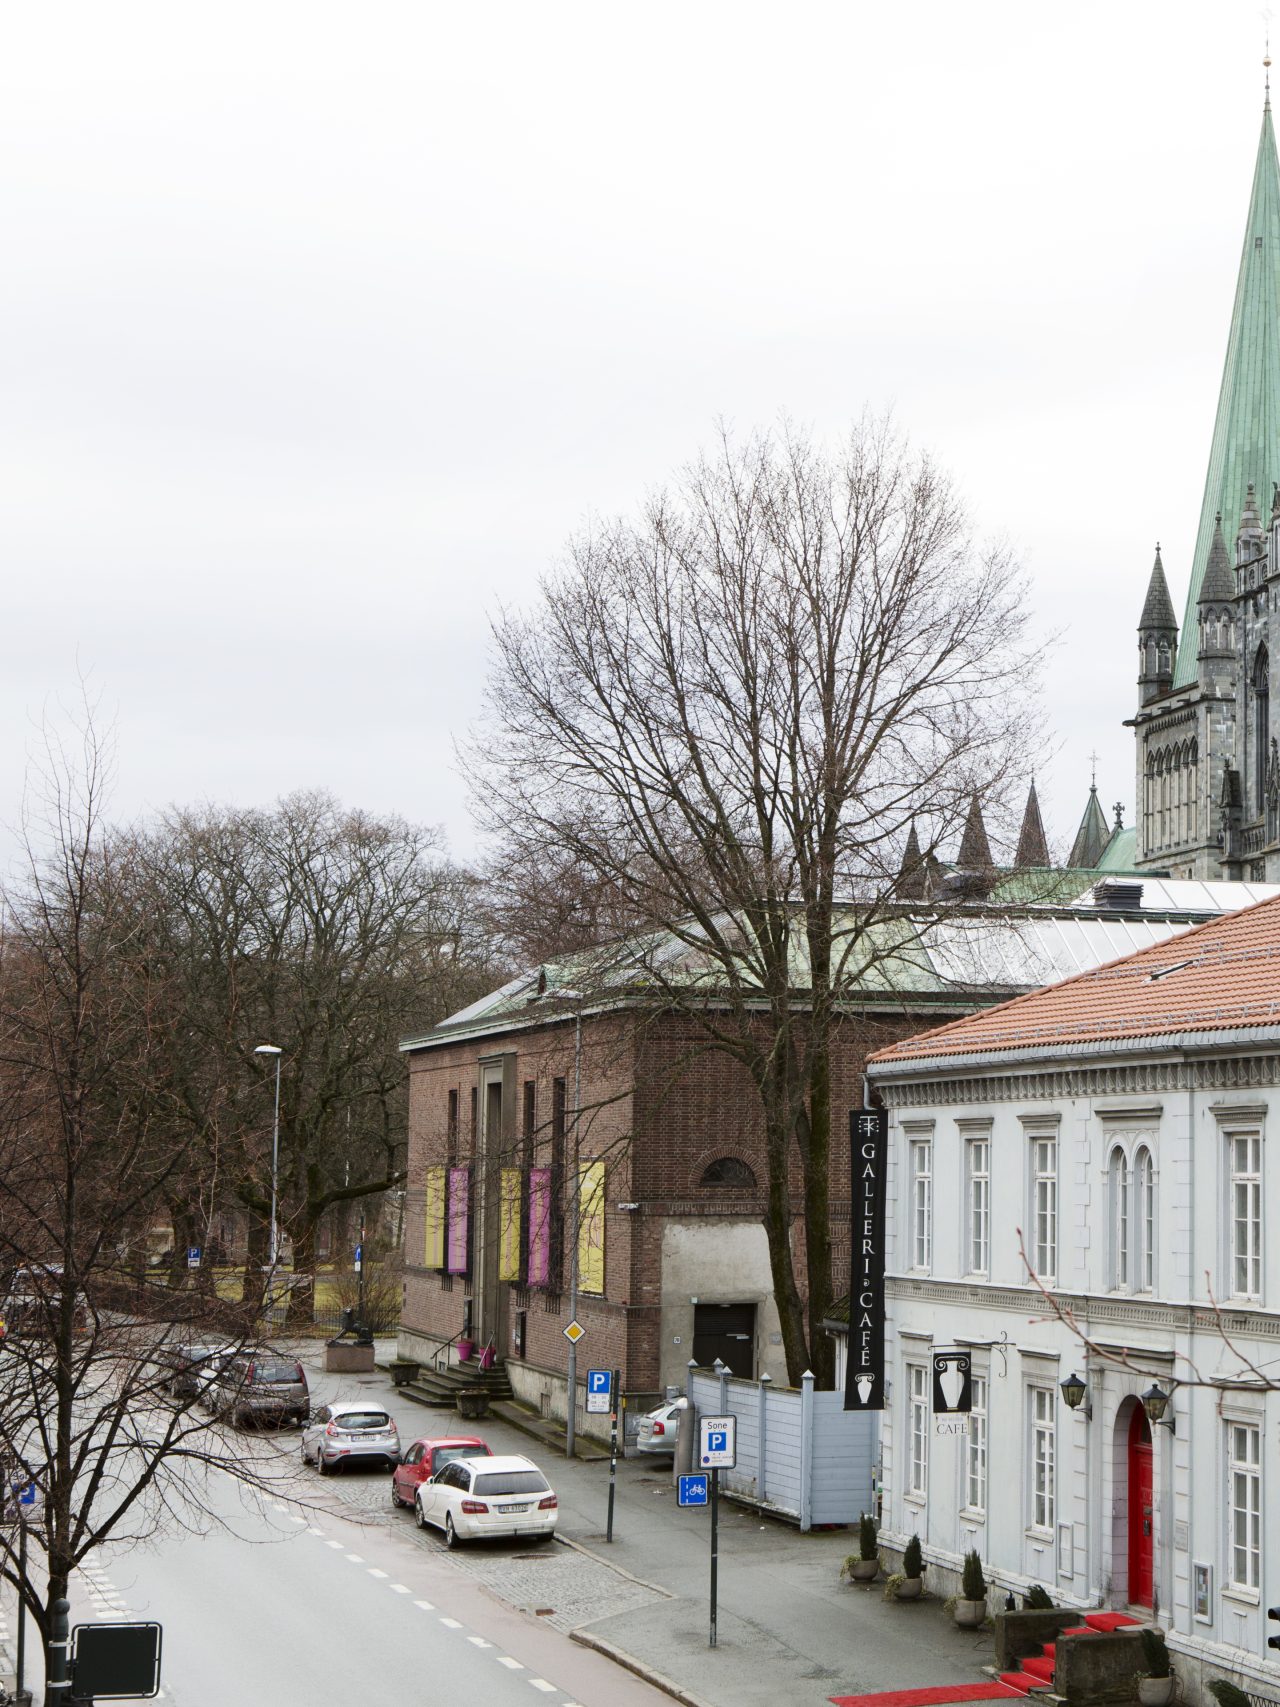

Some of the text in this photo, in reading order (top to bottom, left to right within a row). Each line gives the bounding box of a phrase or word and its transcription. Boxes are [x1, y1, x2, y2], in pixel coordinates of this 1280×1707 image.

[861, 1143, 876, 1274] GALLERI
[859, 1292, 873, 1366] CAFÉ
[593, 1373, 605, 1392] P
[707, 1421, 728, 1430] Sone
[712, 1434, 722, 1450] P
